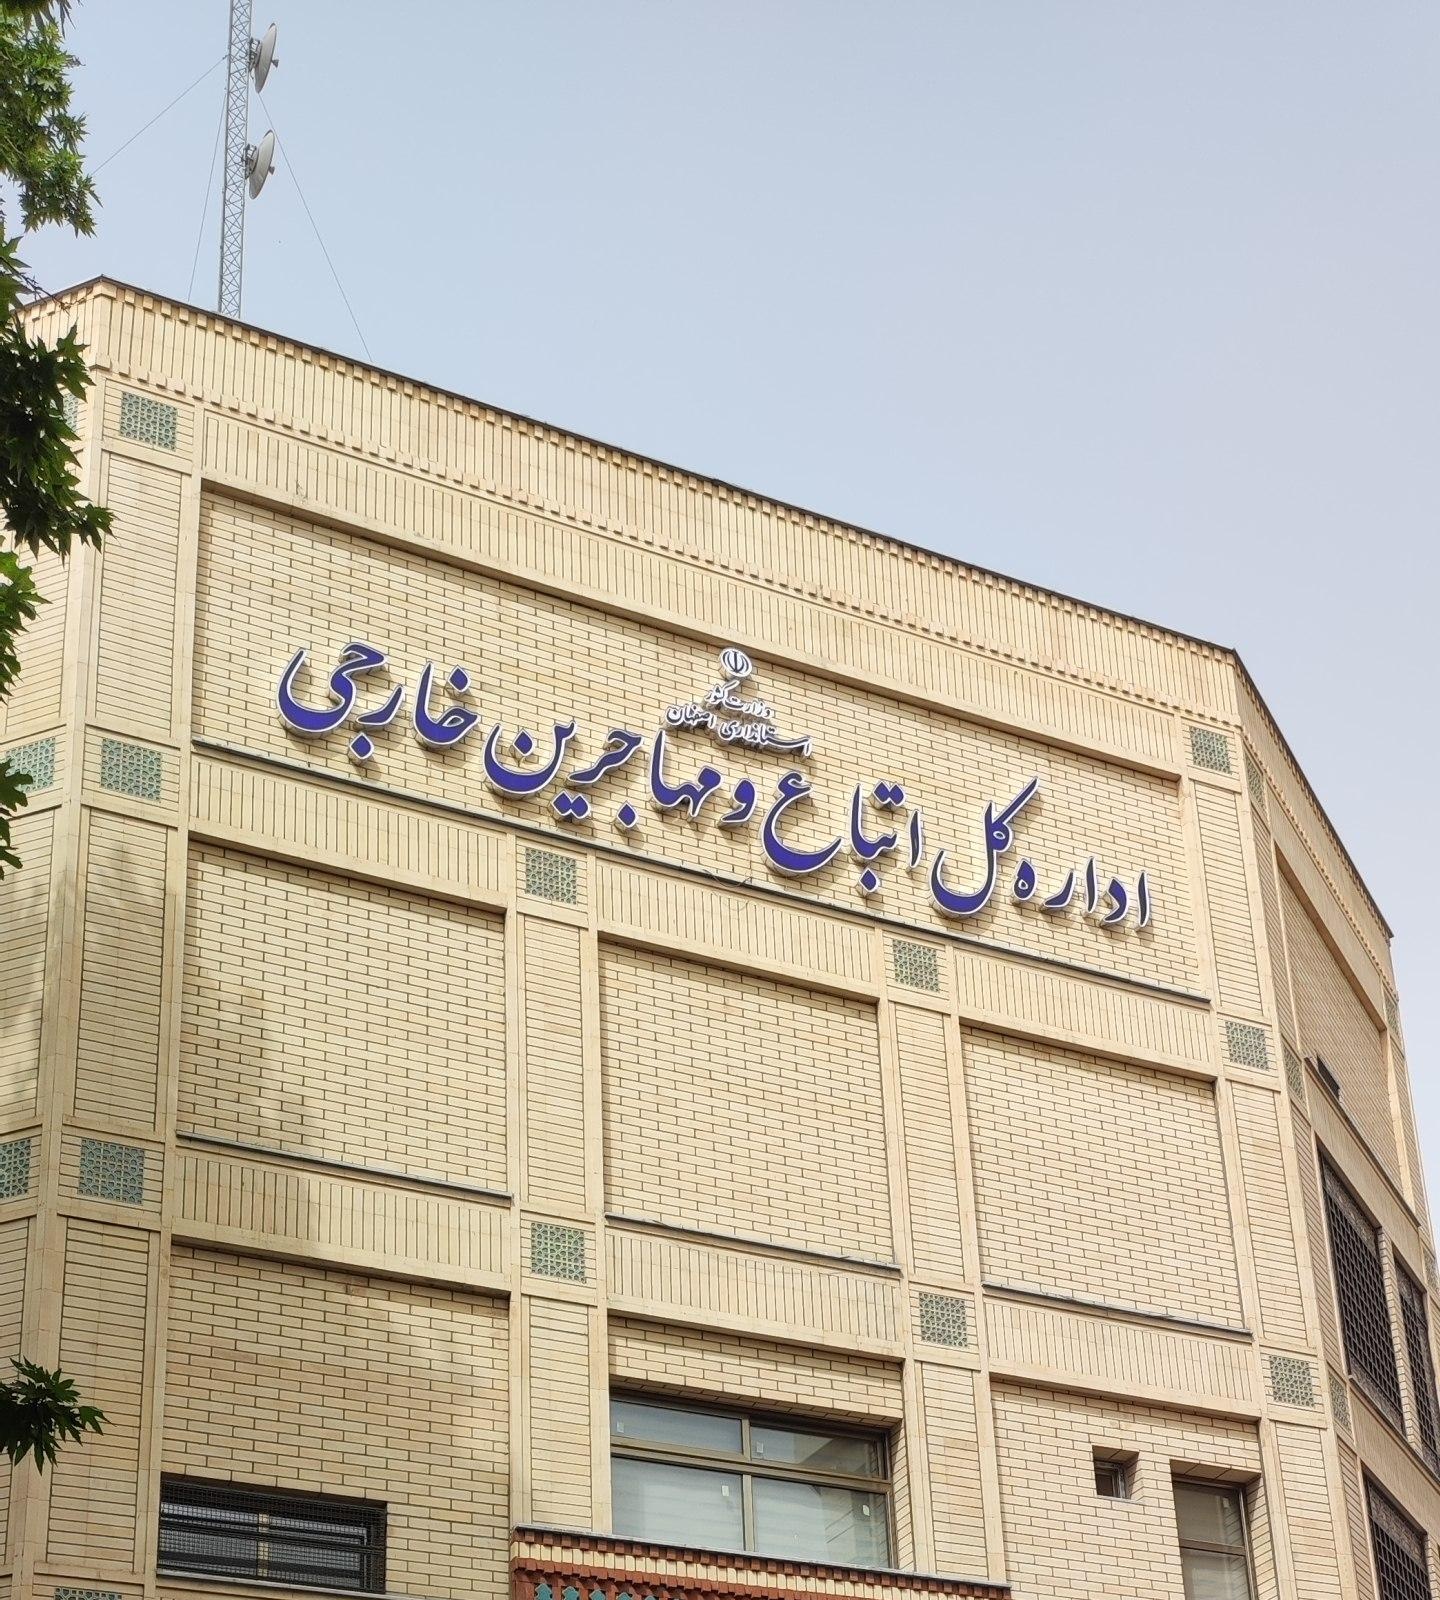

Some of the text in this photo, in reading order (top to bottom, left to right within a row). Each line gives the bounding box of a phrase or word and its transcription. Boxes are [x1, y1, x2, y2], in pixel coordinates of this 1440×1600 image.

[705, 680, 773, 718] وزارت کشور
[666, 704, 813, 757] استانداری اصفهان
[275, 641, 1151, 931] اداره کل اتباع و مهاجرین خارجی
